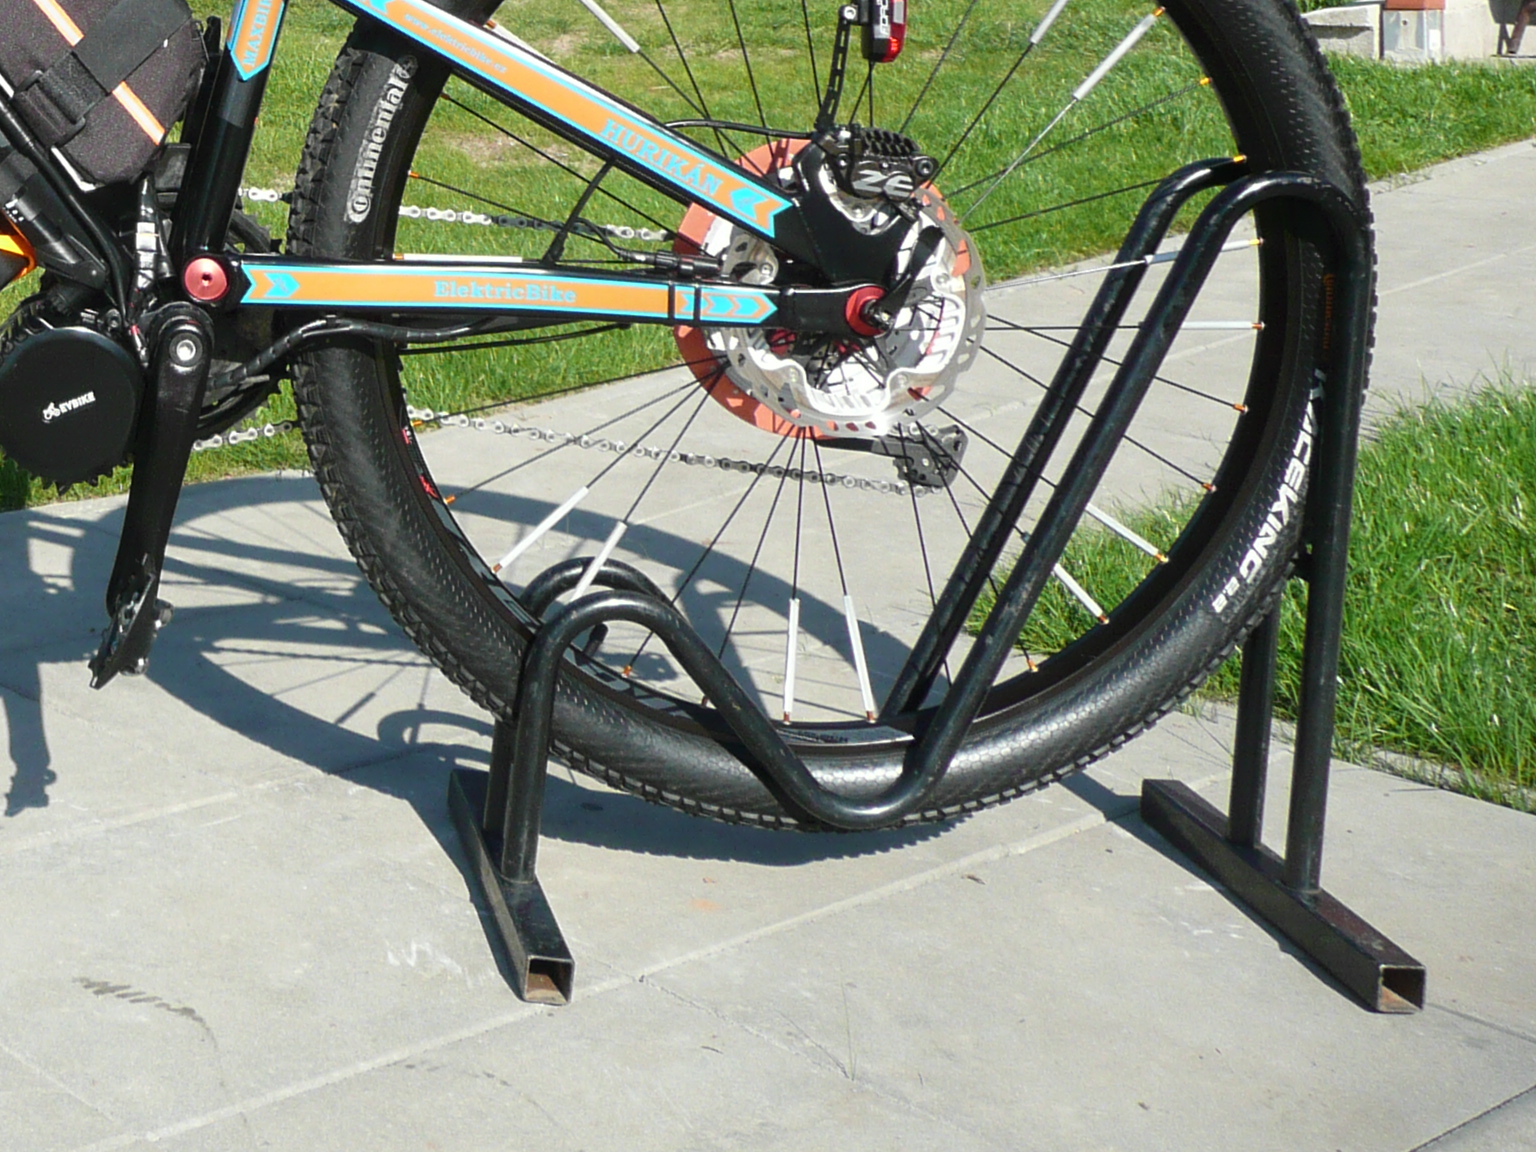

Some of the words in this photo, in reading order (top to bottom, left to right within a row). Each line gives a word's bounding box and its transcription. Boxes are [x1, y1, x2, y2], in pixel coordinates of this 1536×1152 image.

[348, 65, 410, 223] Continental
[598, 118, 722, 195] HURIKÁN
[433, 279, 577, 304] ElektricBike
[58, 391, 96, 413] EVBIKE
